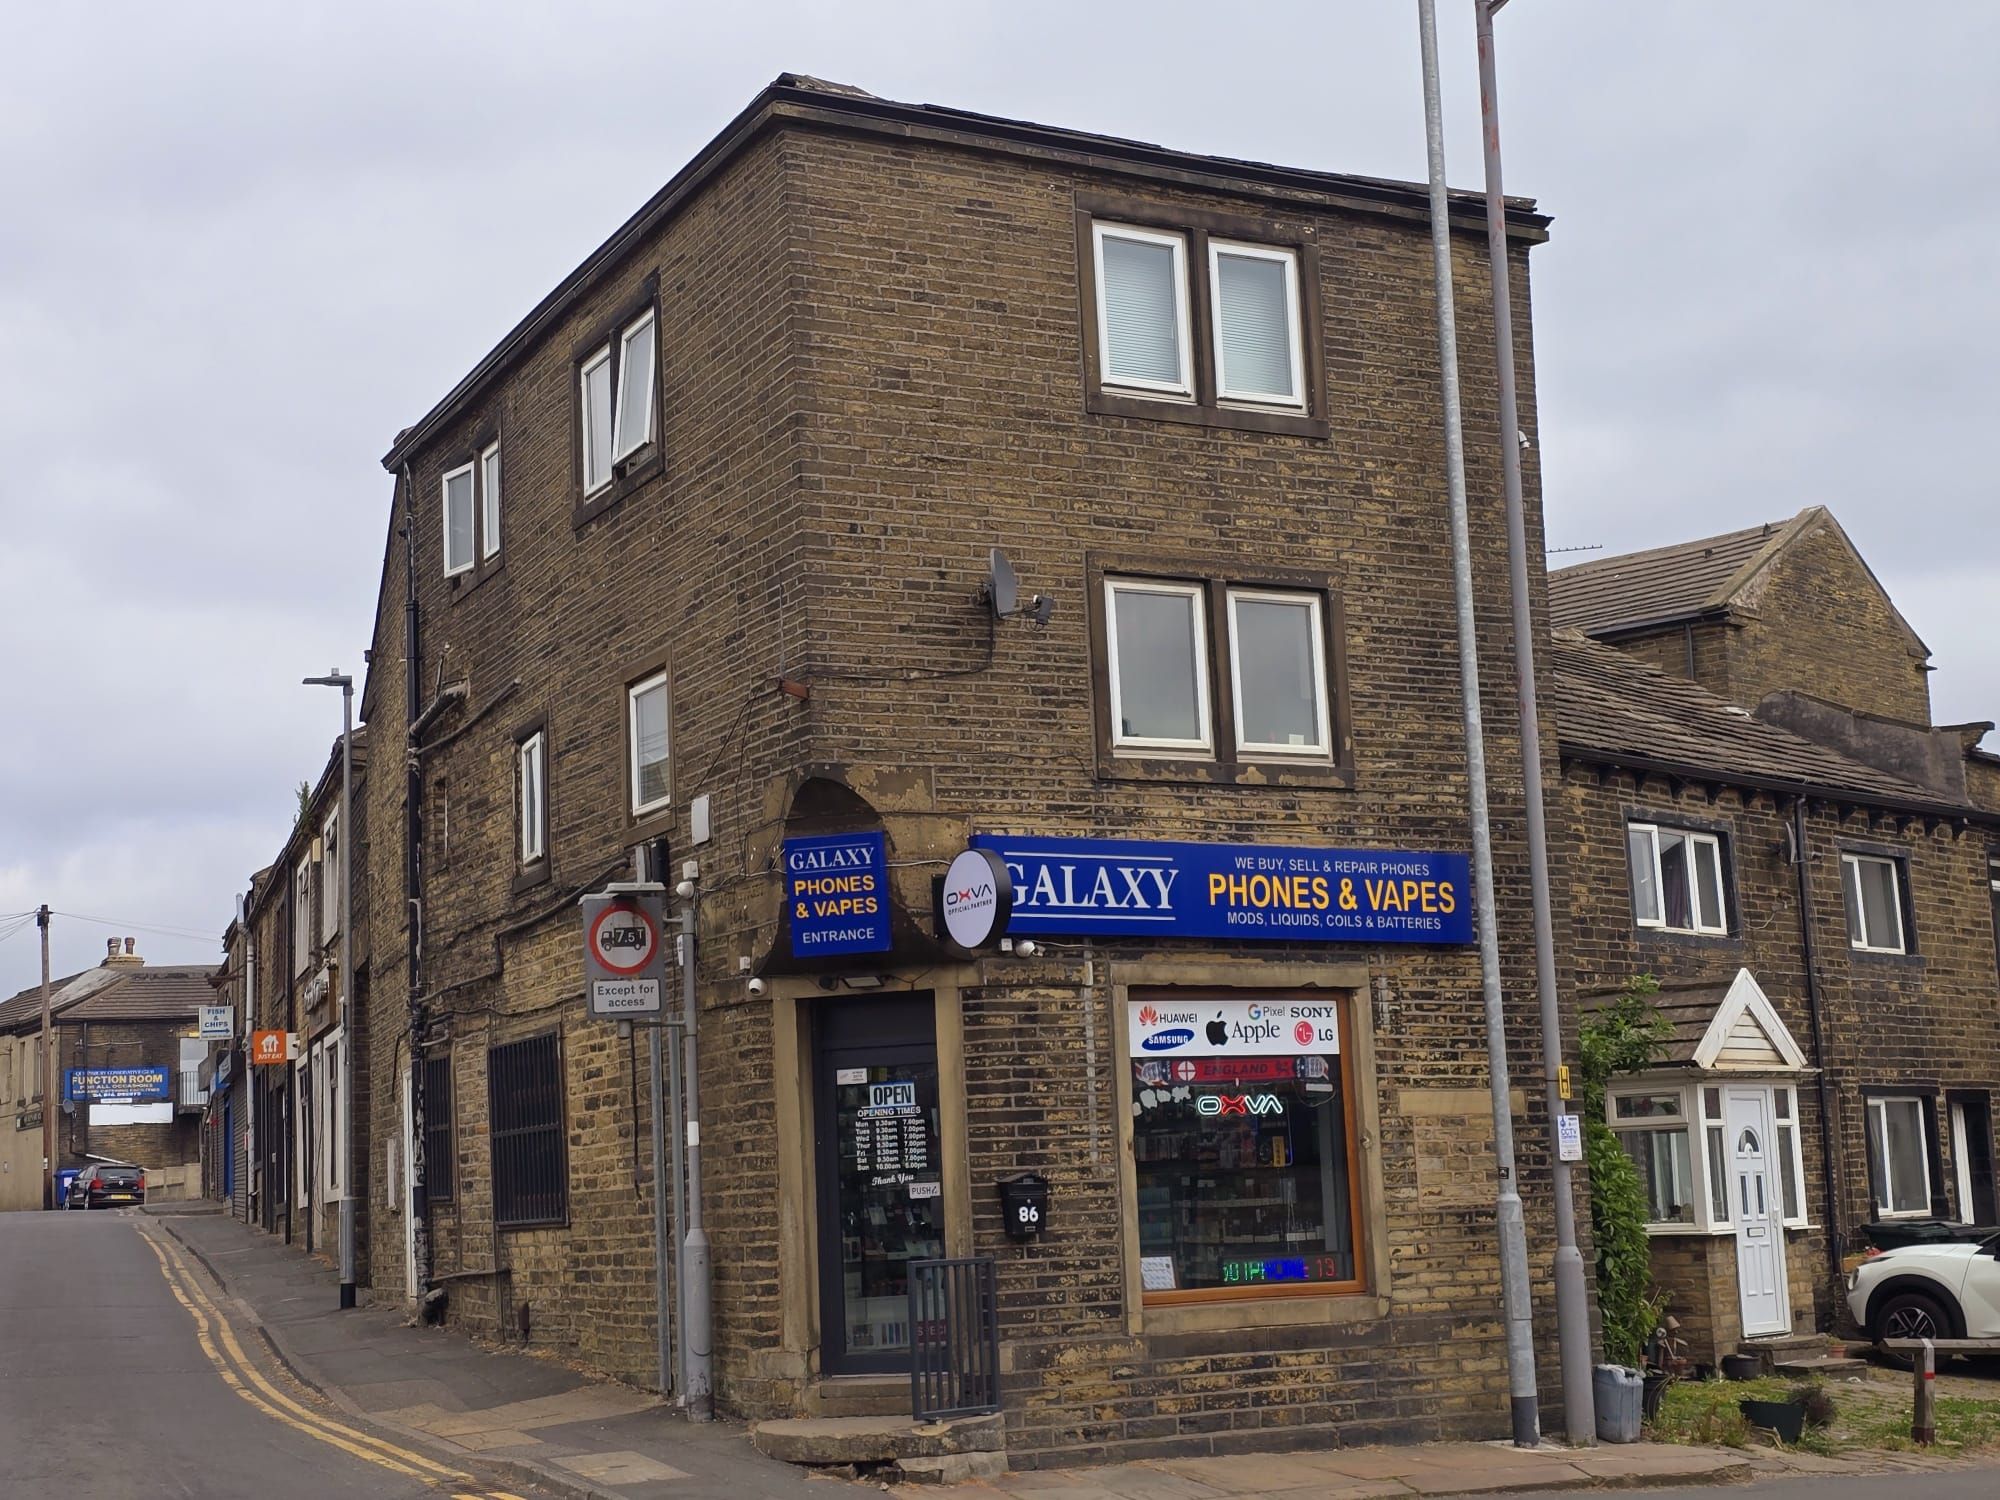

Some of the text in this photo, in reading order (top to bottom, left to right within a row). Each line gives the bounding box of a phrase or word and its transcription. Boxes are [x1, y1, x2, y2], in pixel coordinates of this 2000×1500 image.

[790, 847, 874, 870] GALAXY
[1235, 857, 1430, 876] WE BUY, SELL & REPAIR PHONES
[794, 875, 875, 896] PHONES
[1005, 862, 1179, 910] GALAXY
[946, 884, 992, 906] OXVA
[1208, 874, 1456, 914] PHONES & VAPES
[796, 897, 878, 918] & VAPES
[948, 898, 992, 916] OFFICIAL PARTNER
[1228, 912, 1442, 930] MODS, LIQUIDS, COILS & BATTERIES
[802, 928, 876, 944] ENTRANCE
[598, 984, 655, 996] Except for
[608, 998, 645, 1008] access
[1160, 1012, 1198, 1024] HUAWEI
[1263, 1006, 1286, 1017] Pixel
[1290, 1007, 1333, 1018] SONY
[1148, 1034, 1188, 1044] SAMSUNG
[1232, 1020, 1280, 1044] Apple
[1318, 1028, 1334, 1040] LG
[1204, 1064, 1268, 1075] ENGLAND
[72, 1074, 162, 1085] FUNCTION ROOM
[873, 1086, 912, 1106] OPEN
[857, 1106, 921, 1118] OPENING TIMES
[1198, 1094, 1284, 1116] OXVA
[872, 1172, 914, 1186] Thank You
[912, 1186, 931, 1194] PUSH
[1018, 1206, 1038, 1222] 86
